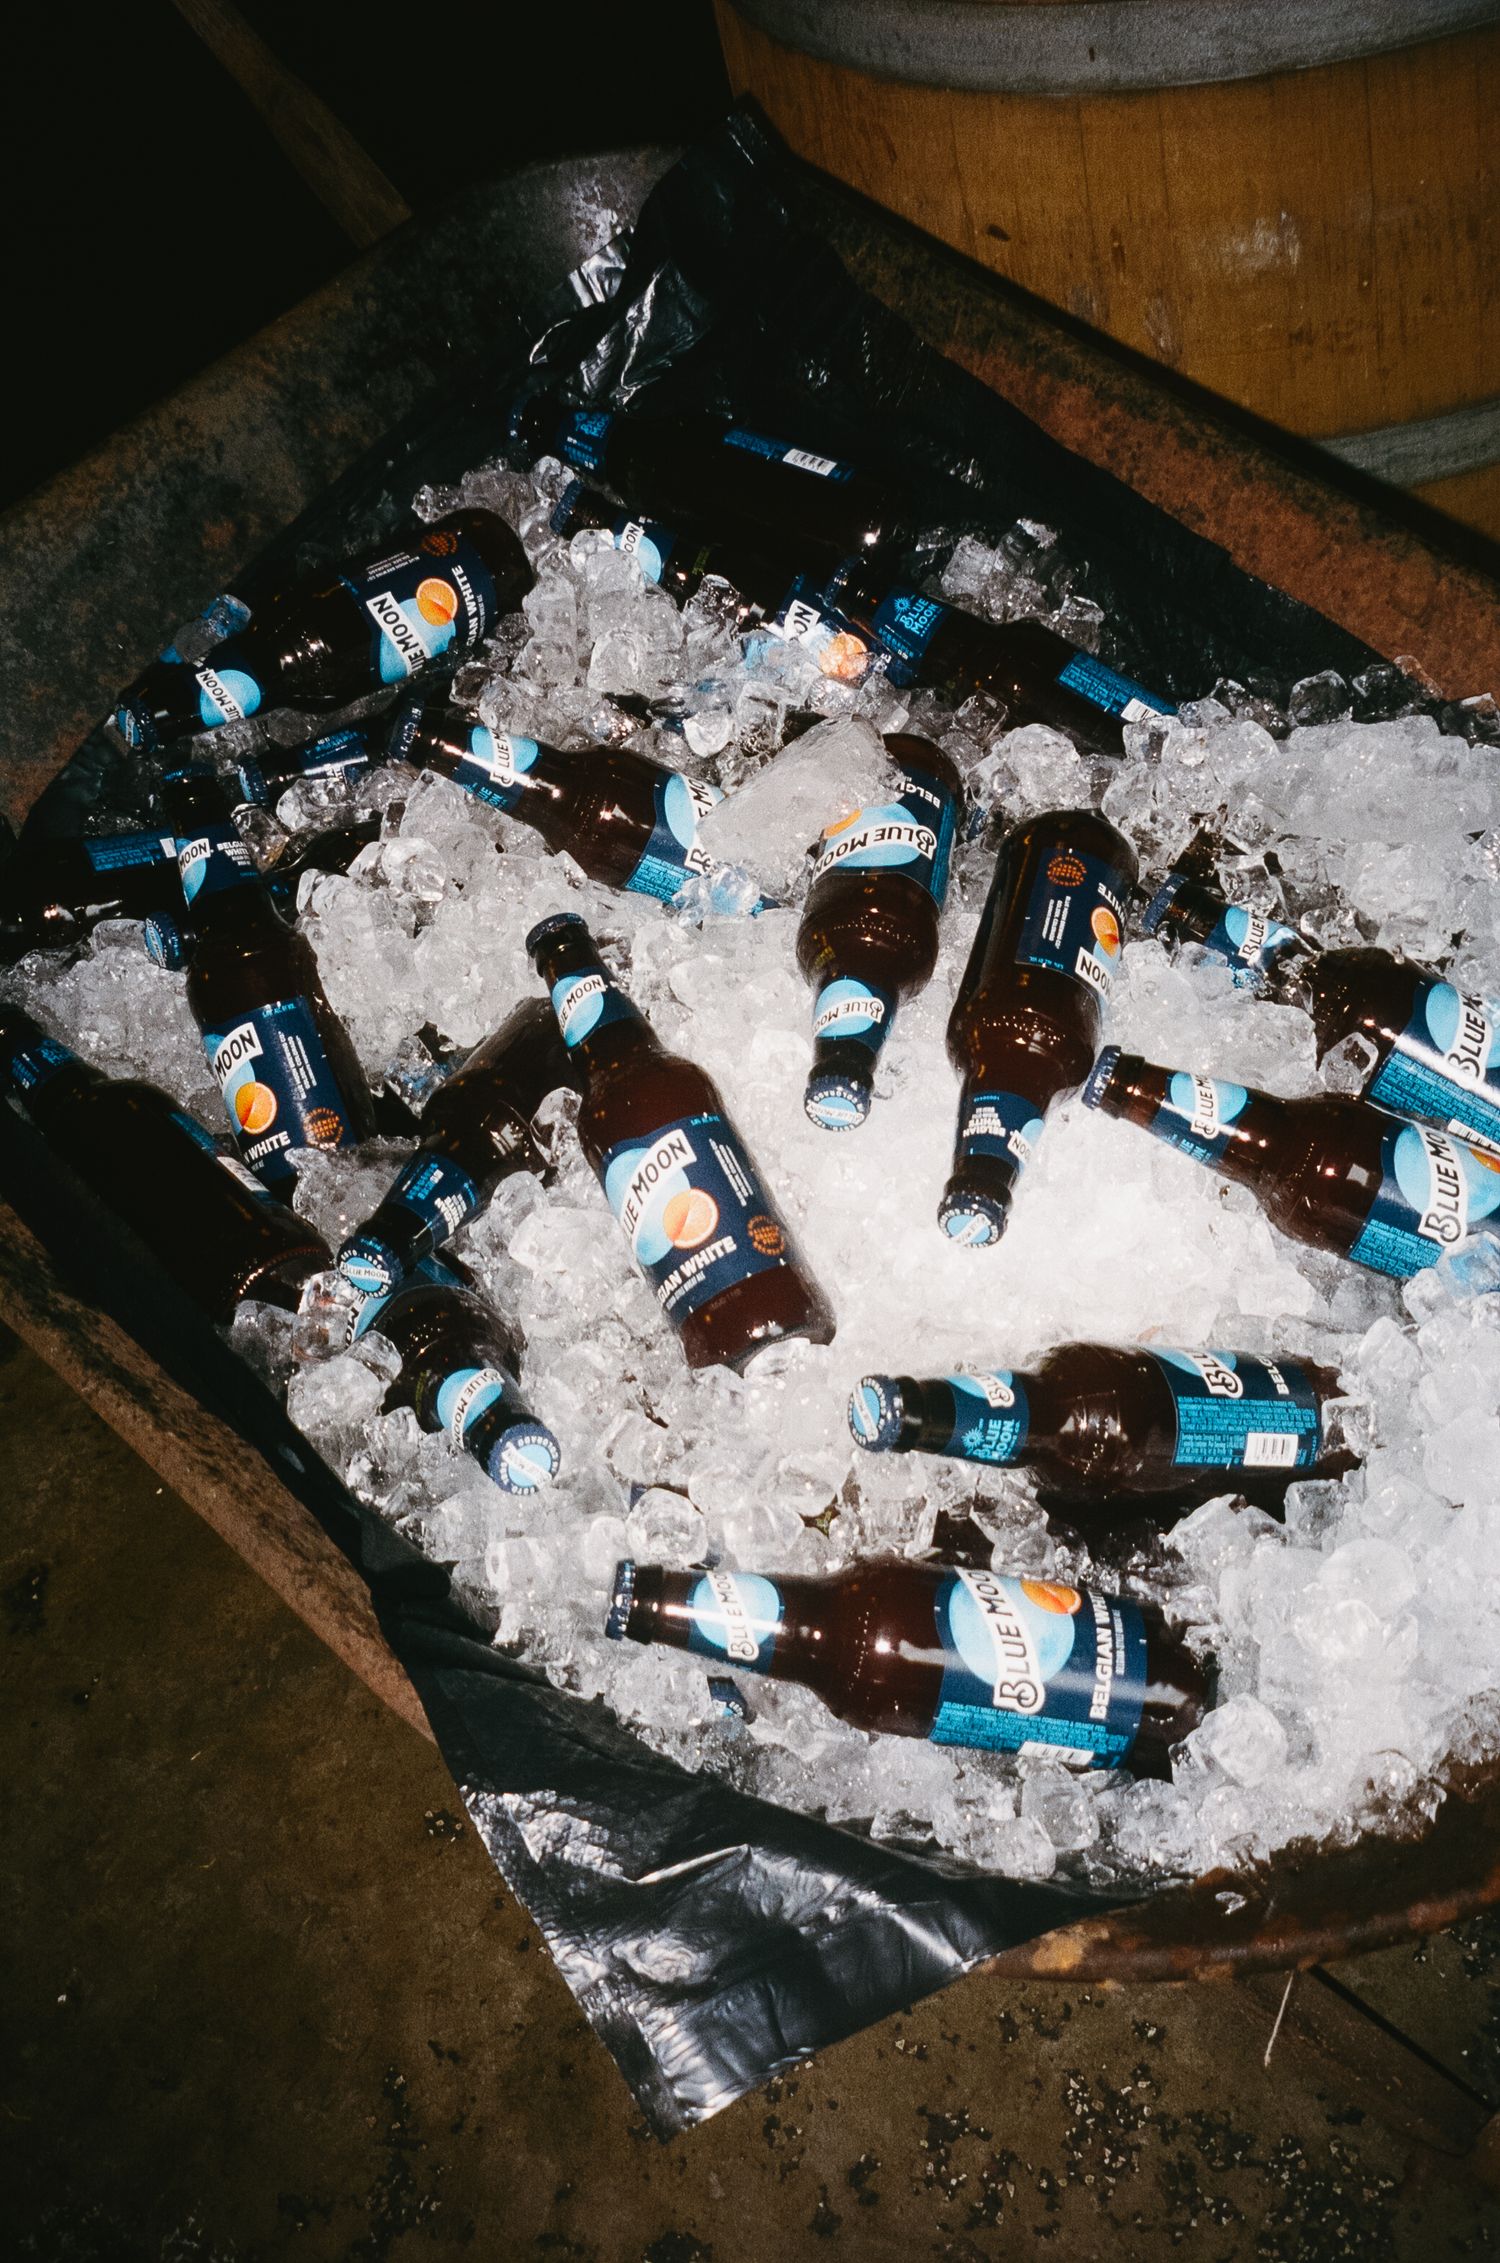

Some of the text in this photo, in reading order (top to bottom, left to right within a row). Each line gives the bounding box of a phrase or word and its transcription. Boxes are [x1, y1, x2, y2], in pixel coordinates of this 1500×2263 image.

[624, 525, 640, 553] OON
[451, 565, 479, 647] GIAN WHITE
[900, 598, 929, 629] BLUE
[910, 603, 939, 635] MOON
[372, 597, 427, 671] UE MOON
[200, 672, 232, 706] MOON
[688, 778, 713, 806] MO
[900, 782, 941, 809] BELGI
[179, 842, 208, 873] MOON
[873, 826, 935, 857] BLUE
[1242, 921, 1265, 957] BLUE
[1080, 955, 1110, 995] OON
[566, 978, 602, 1010] MOON
[814, 1000, 882, 1031] BLUE MOO
[214, 1029, 257, 1084] MOON
[1448, 1012, 1486, 1077] BLUE
[962, 1126, 1006, 1138] BELGIAN
[968, 1118, 1001, 1129] WHITE
[248, 1130, 291, 1163] WHITE
[1013, 1138, 1031, 1160] OON
[631, 1137, 688, 1205] MOON
[1424, 1131, 1461, 1243] BLUE MO
[341, 1262, 388, 1280] BLUE MOON
[656, 1270, 683, 1302] GIAN
[679, 1235, 738, 1276] WHITE
[1256, 1355, 1290, 1395] BELG
[453, 1398, 469, 1445] MOON
[713, 1573, 738, 1604] MOO
[968, 1571, 1039, 1709] BLUE MOO
[1089, 1626, 1112, 1720] BELGIAN
